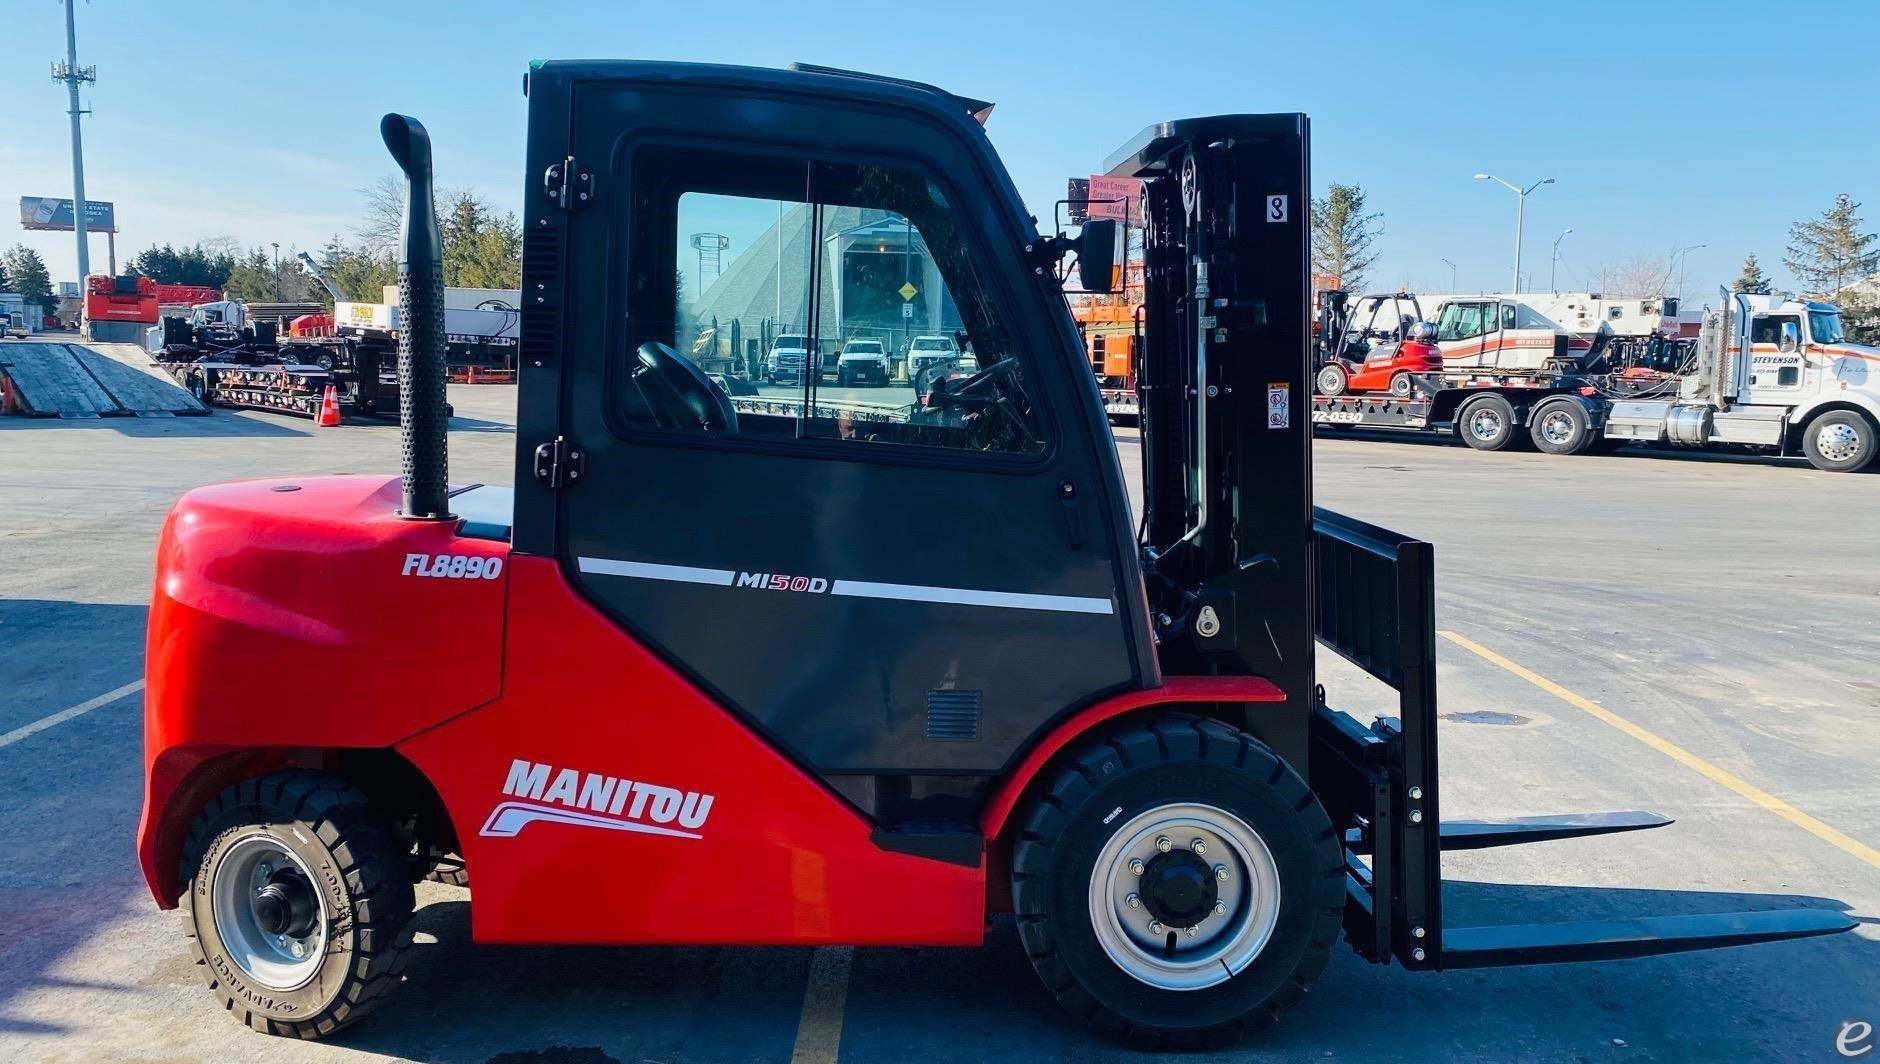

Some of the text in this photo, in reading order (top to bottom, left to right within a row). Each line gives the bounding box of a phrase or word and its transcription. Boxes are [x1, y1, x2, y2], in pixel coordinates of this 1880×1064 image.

[1093, 180, 1109, 189] Great
[1752, 356, 1800, 364] STEVENSON
[401, 553, 503, 580] FL8890
[736, 571, 828, 594] MI50D
[502, 758, 715, 829] MANITOU
